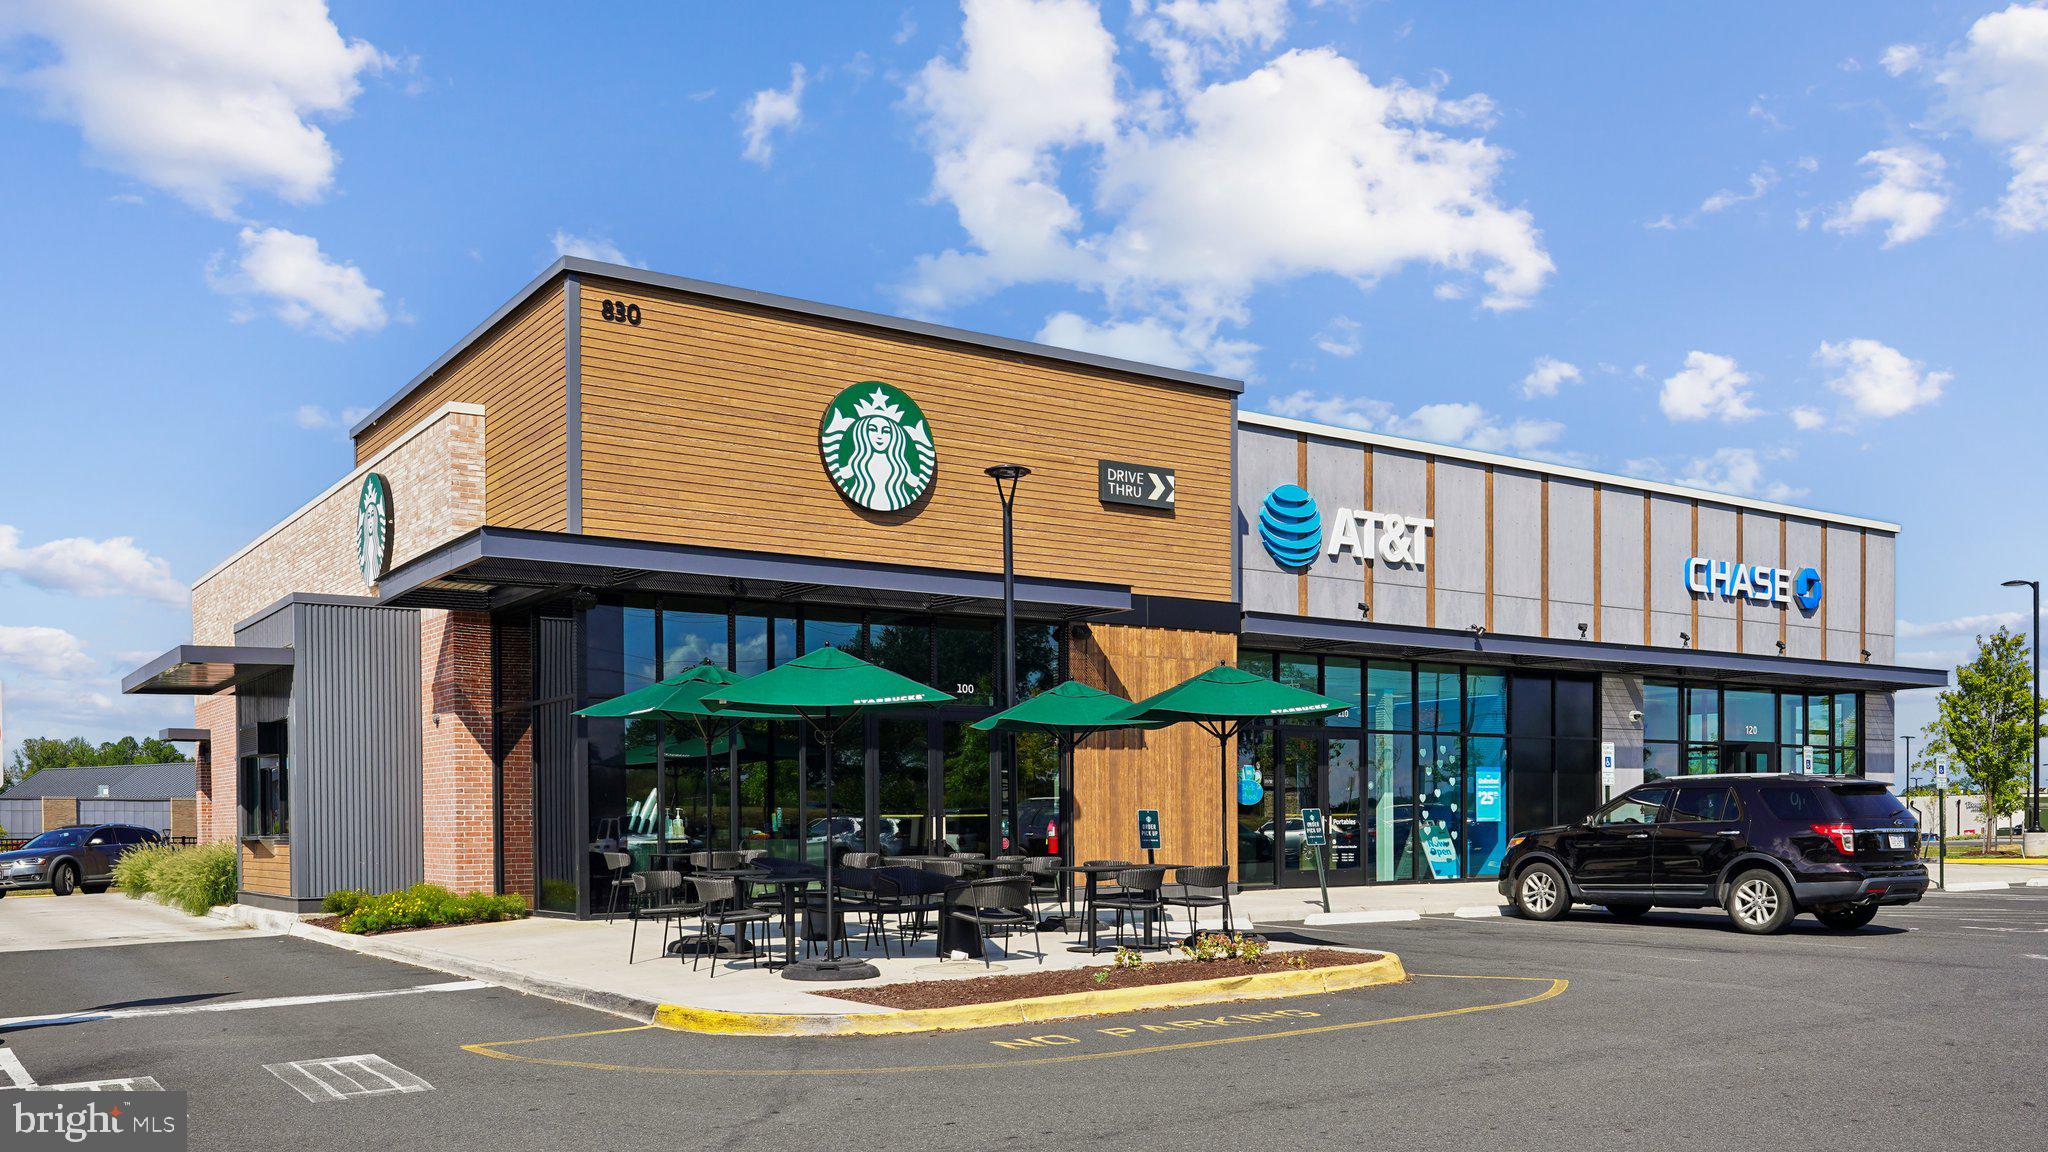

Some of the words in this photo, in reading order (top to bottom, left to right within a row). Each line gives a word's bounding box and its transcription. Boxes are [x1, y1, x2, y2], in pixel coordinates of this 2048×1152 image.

[601, 299, 641, 327] 830
[1107, 468, 1144, 485] DRIVE
[1107, 481, 1142, 498] THRU
[1327, 507, 1434, 565] AT&T
[1684, 557, 1792, 603] CHASE
[956, 683, 974, 694] 100
[853, 694, 925, 704] STARBUCKS
[1270, 704, 1329, 714] STARBUCKS
[1745, 725, 1758, 735] 120
[1430, 847, 1453, 858] Open
[990, 1034, 1081, 1051] NO
[1097, 1008, 1321, 1038] PARKING
